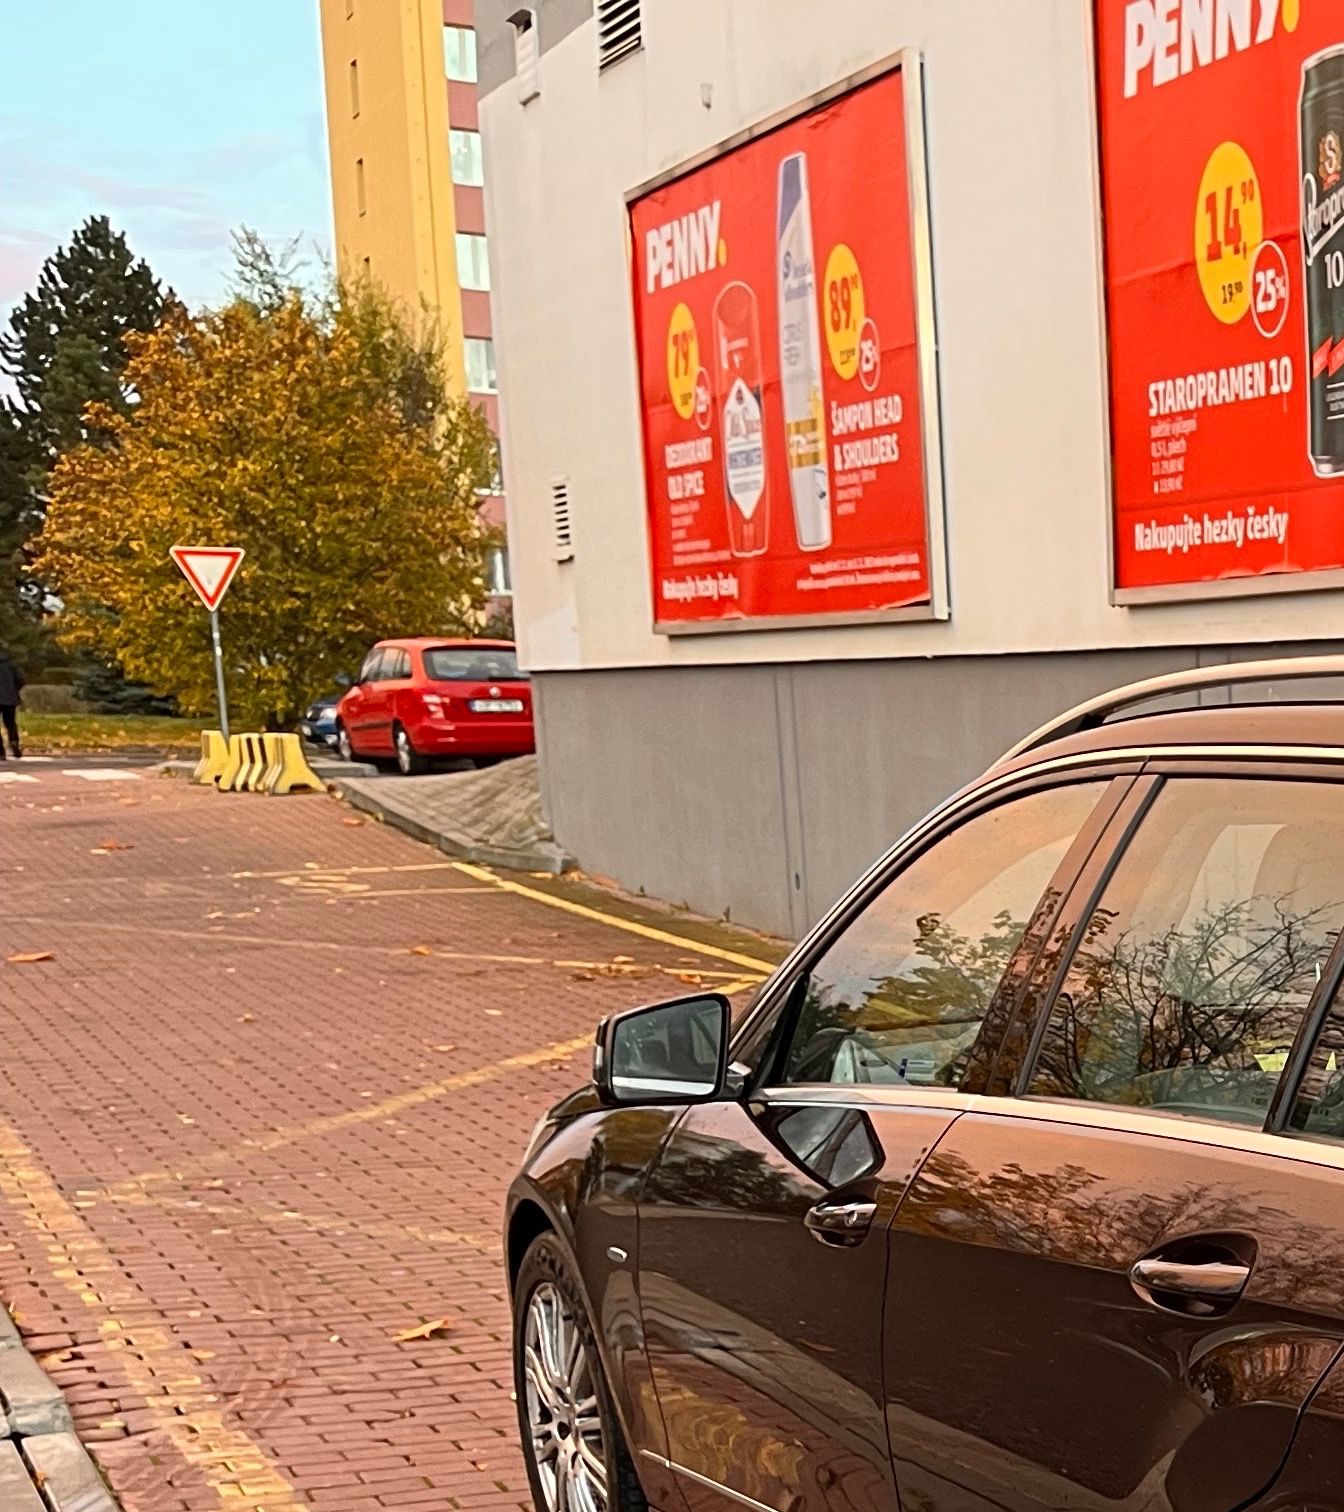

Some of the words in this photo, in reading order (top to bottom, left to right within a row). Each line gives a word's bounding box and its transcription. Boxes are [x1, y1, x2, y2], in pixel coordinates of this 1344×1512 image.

[1255, 268, 1286, 313] 25%
[1324, 250, 1344, 289] 10
[1148, 361, 1266, 417] STAROPRAMEN
[1269, 356, 1293, 395] 10
[1135, 514, 1202, 555] Nakupujte
[1203, 511, 1246, 548] hezky
[1246, 505, 1290, 545] česky
